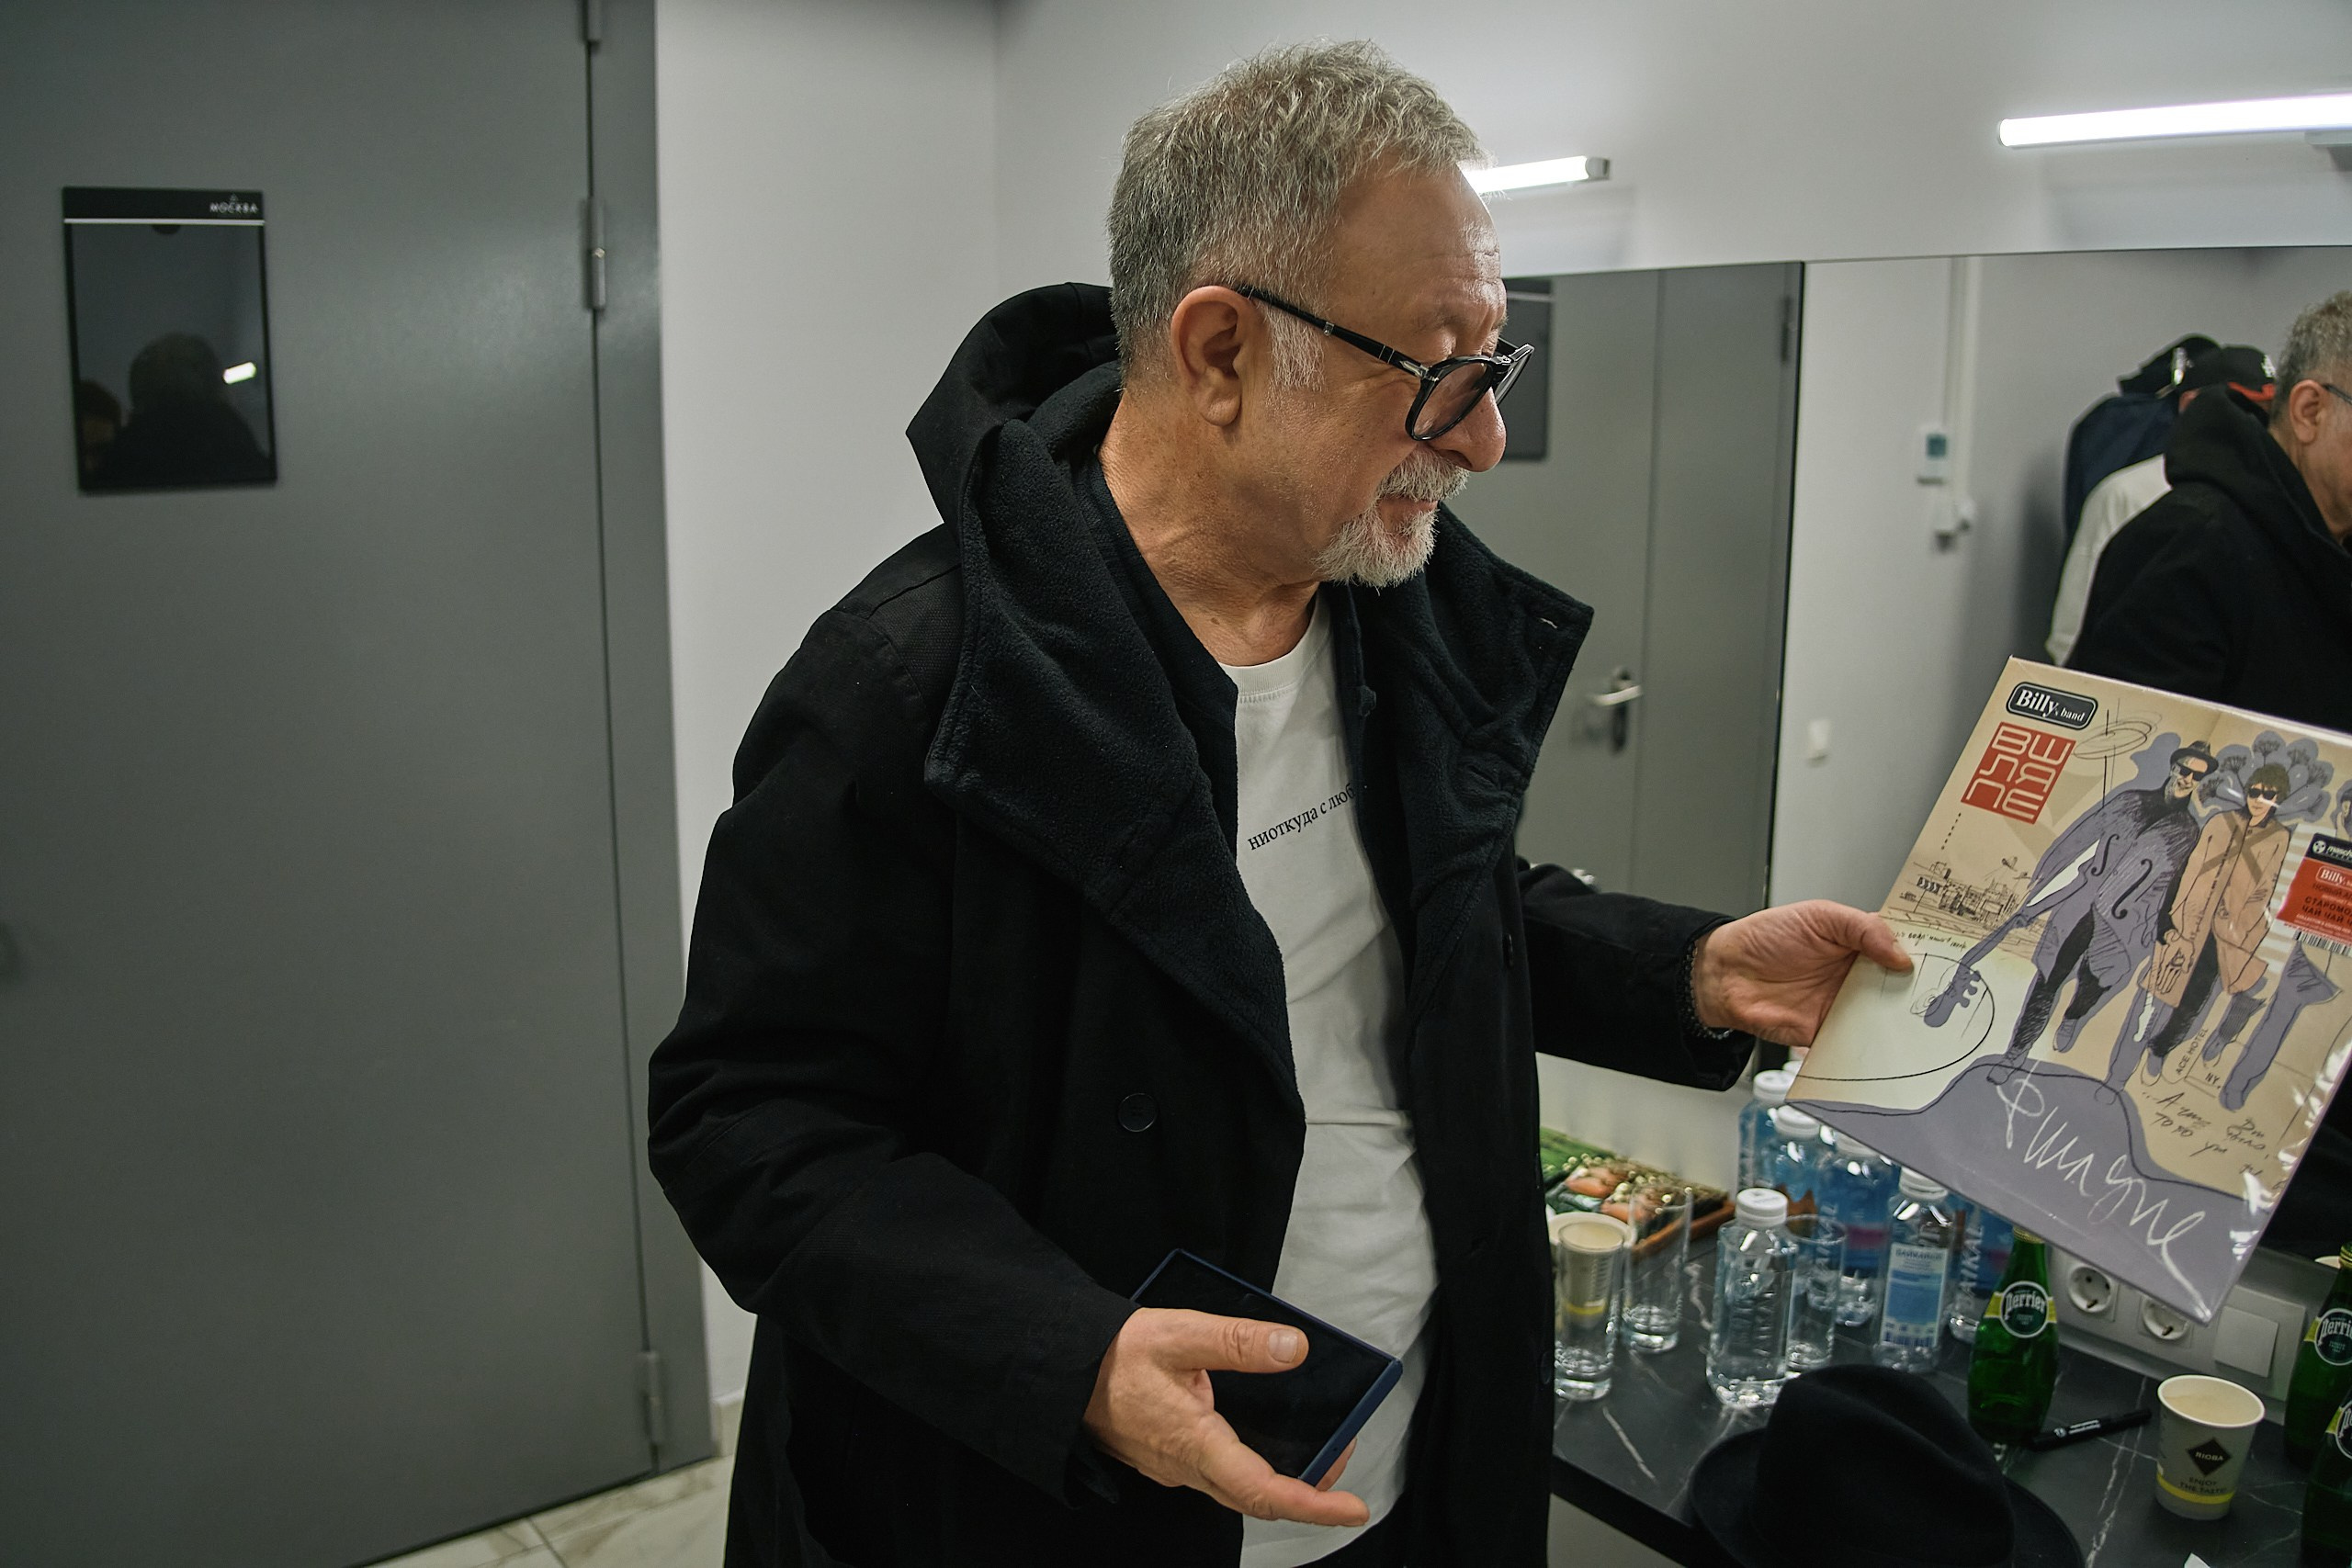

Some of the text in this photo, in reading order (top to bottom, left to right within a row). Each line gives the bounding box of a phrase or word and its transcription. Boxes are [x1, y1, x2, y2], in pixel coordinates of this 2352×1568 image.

[2060, 707, 2086, 723] band
[1247, 806, 1318, 851] ниоткуда
[1319, 799, 1328, 815] с
[2176, 1028, 2209, 1076] ACE HOTEL
[2004, 1292, 2046, 1321] Perrier
[2194, 1451, 2224, 1461] RIOBA
[2178, 1482, 2196, 1493] THE
[2188, 1476, 2217, 1487] ENJOY
